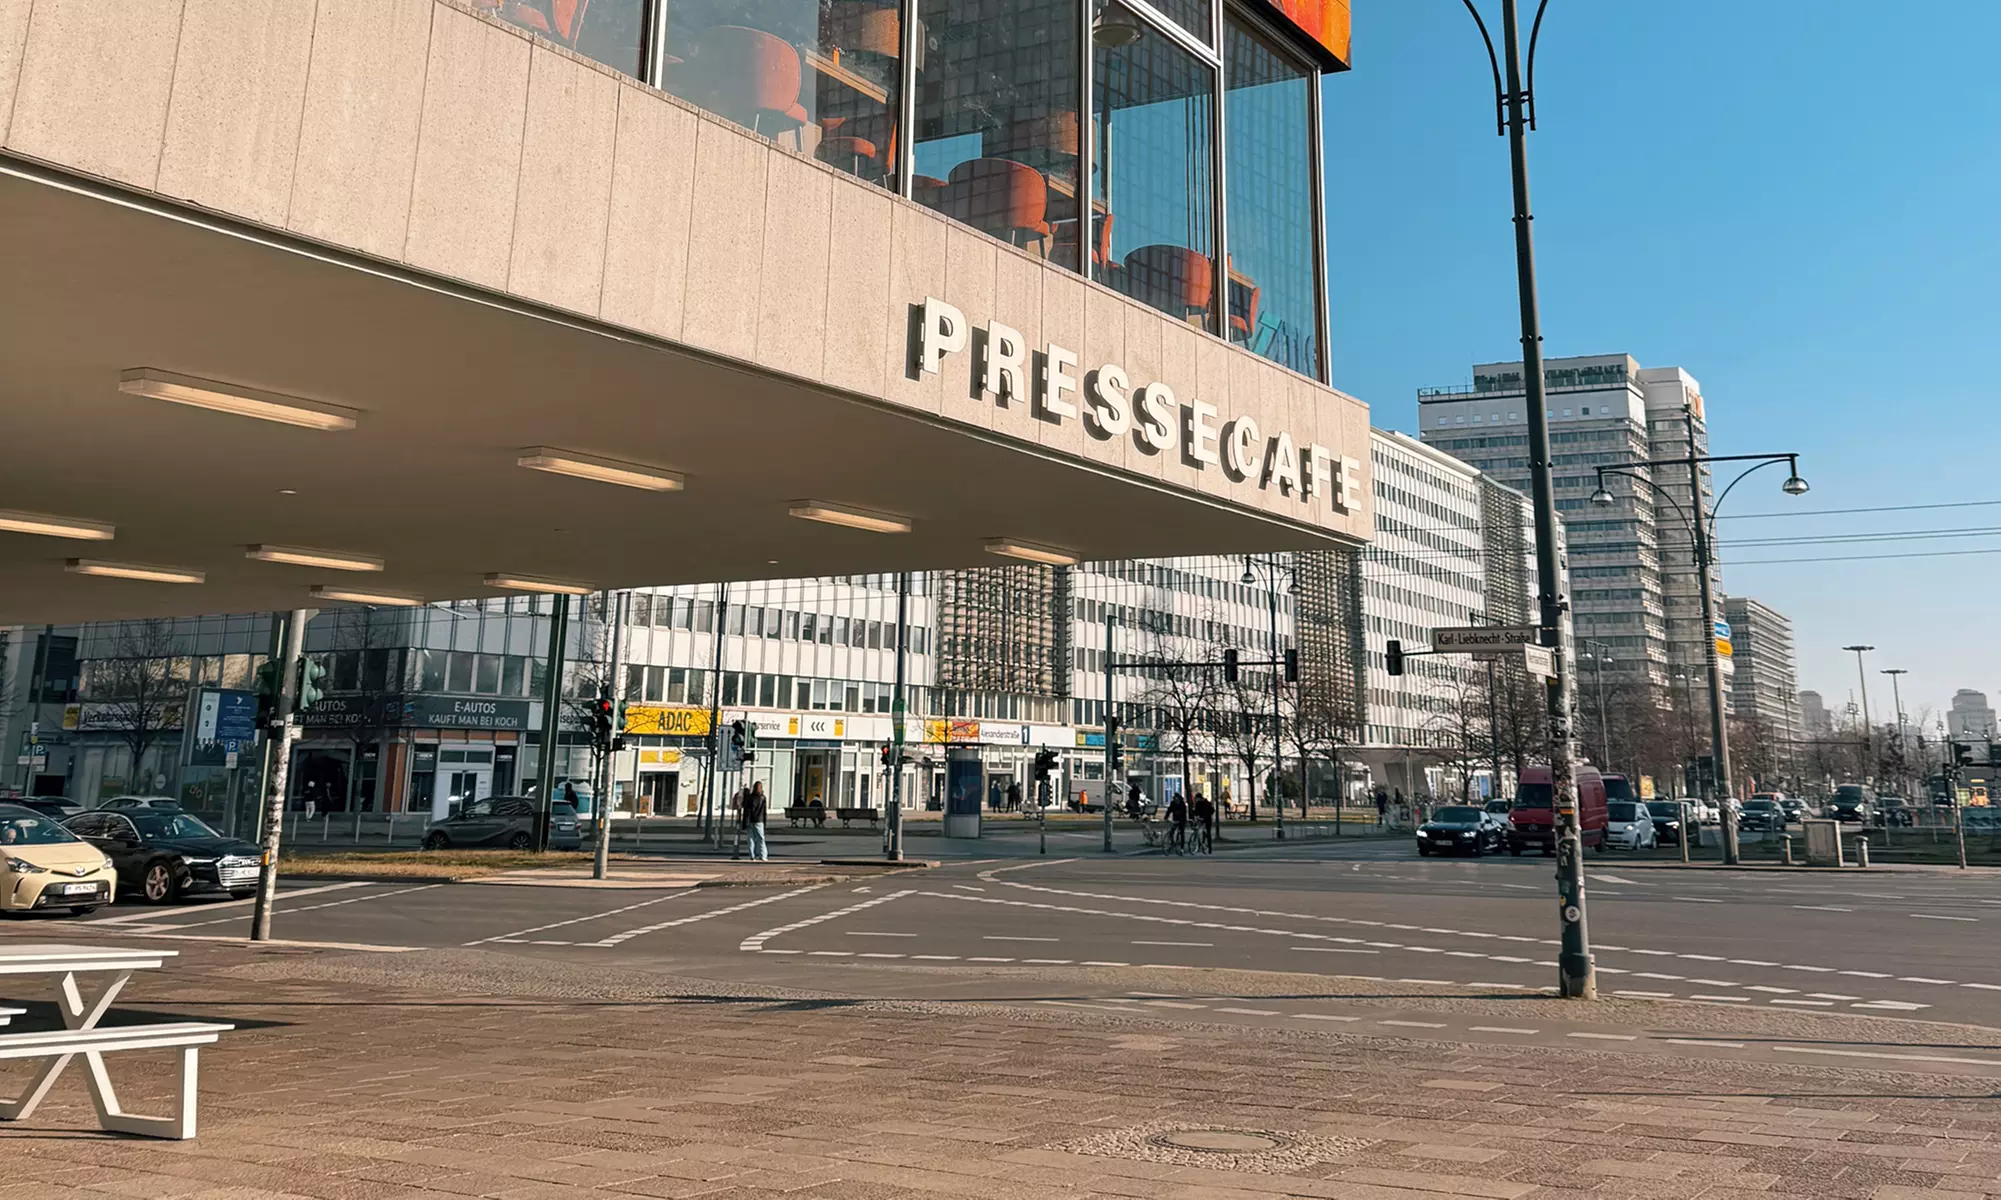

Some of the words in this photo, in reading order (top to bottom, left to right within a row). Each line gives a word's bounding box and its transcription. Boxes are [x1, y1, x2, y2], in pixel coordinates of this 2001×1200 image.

[923, 296, 1362, 512] PRESSECAFE
[454, 701, 497, 714] E-AUTOS
[429, 714, 456, 724] KAUFT
[458, 716, 478, 725] MAN
[480, 717, 493, 726] BEI
[495, 717, 518, 727] KOCH
[657, 711, 693, 732] ADAC
